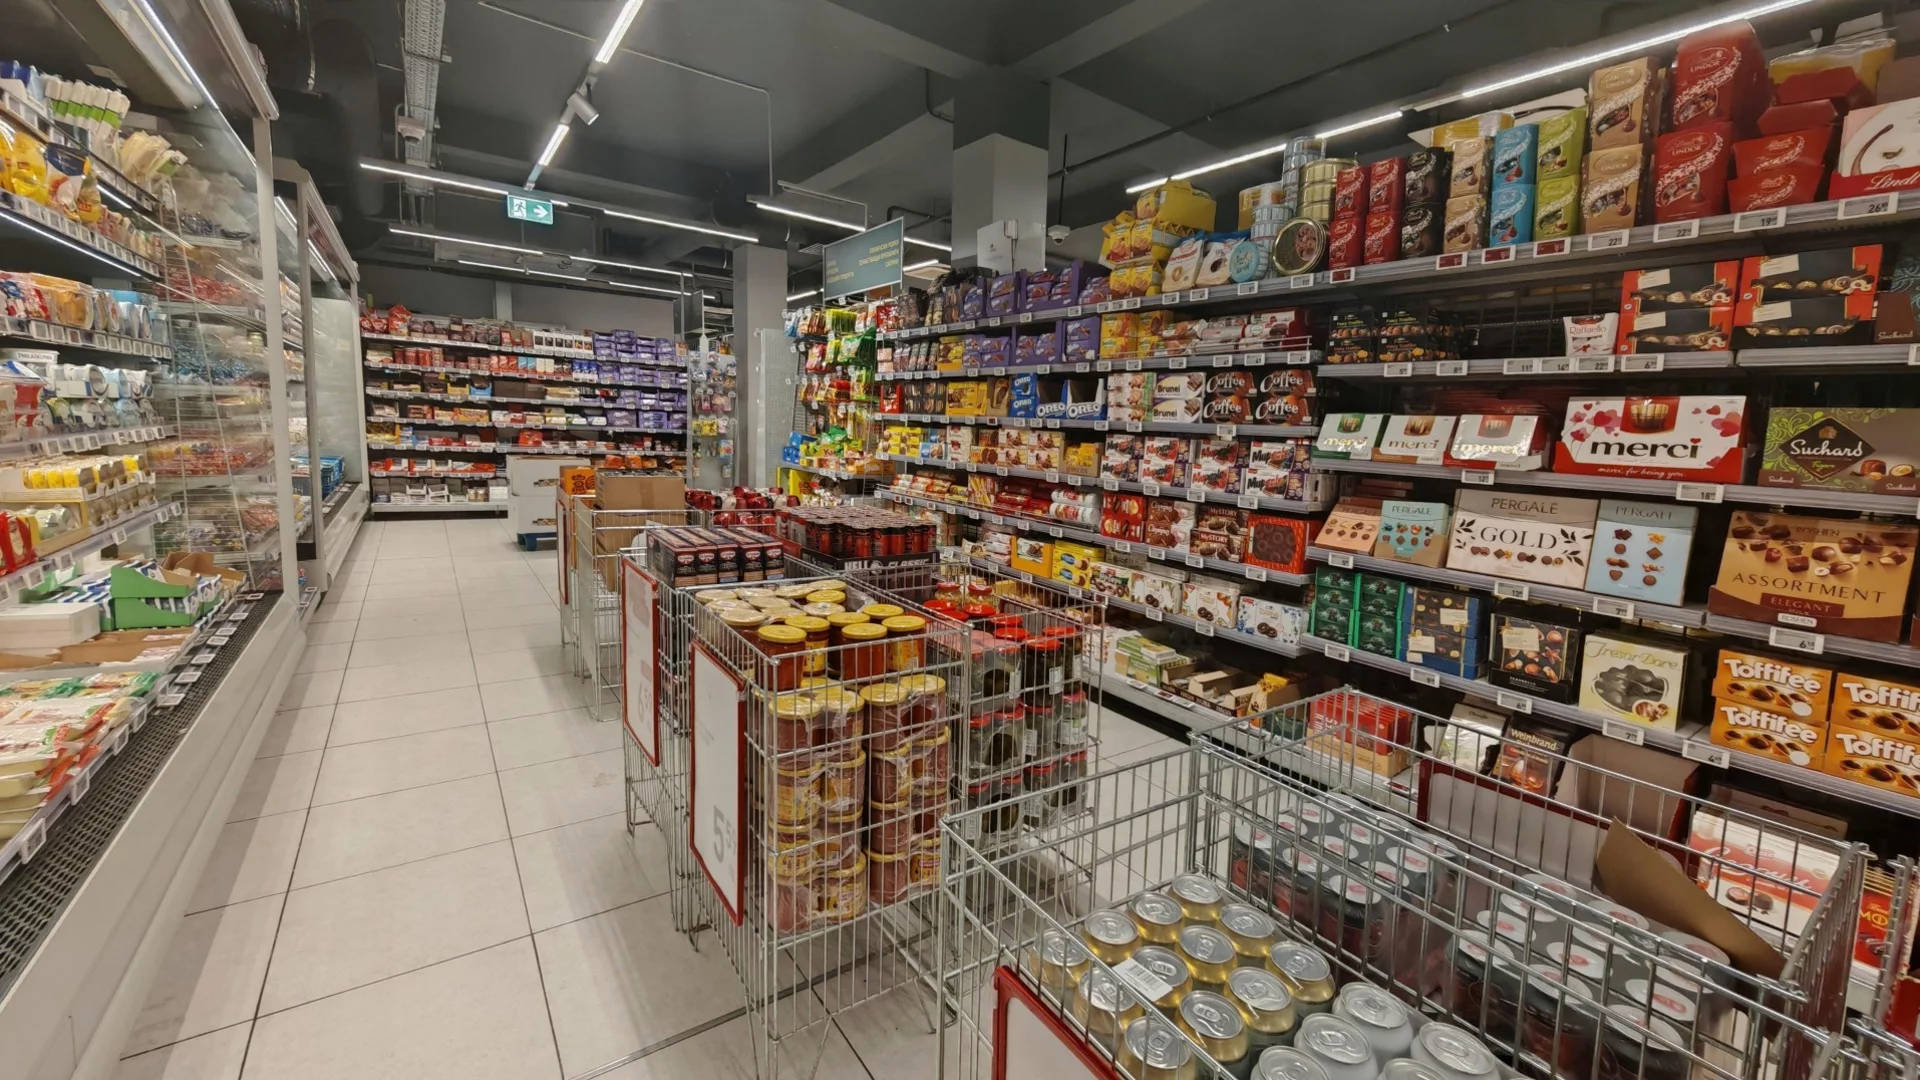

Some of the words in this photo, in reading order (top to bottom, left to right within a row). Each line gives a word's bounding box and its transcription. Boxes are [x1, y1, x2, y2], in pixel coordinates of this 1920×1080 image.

[1760, 216, 1778, 227] 19
[1608, 236, 1623, 247] 22
[1676, 227, 1692, 238] 22
[1569, 325, 1606, 335] Raffaello
[1206, 371, 1246, 393] Coffee
[1260, 370, 1304, 393] Coffee
[1036, 403, 1066, 417] OREO
[1068, 403, 1101, 418] OREO
[1203, 398, 1242, 418] Coffee
[1255, 398, 1299, 420] Coffee
[1388, 439, 1440, 450] merci
[1590, 438, 1702, 459] merci
[1789, 439, 1863, 458] Suchard
[1641, 468, 1665, 478] being
[1480, 525, 1558, 550] GOLD
[844, 560, 868, 572] HELL
[1732, 572, 1887, 604] ASSORTMENT
[1770, 596, 1833, 613] ELEGANT
[1723, 658, 1821, 694] Toffifee
[1720, 706, 1818, 744] Toffifee
